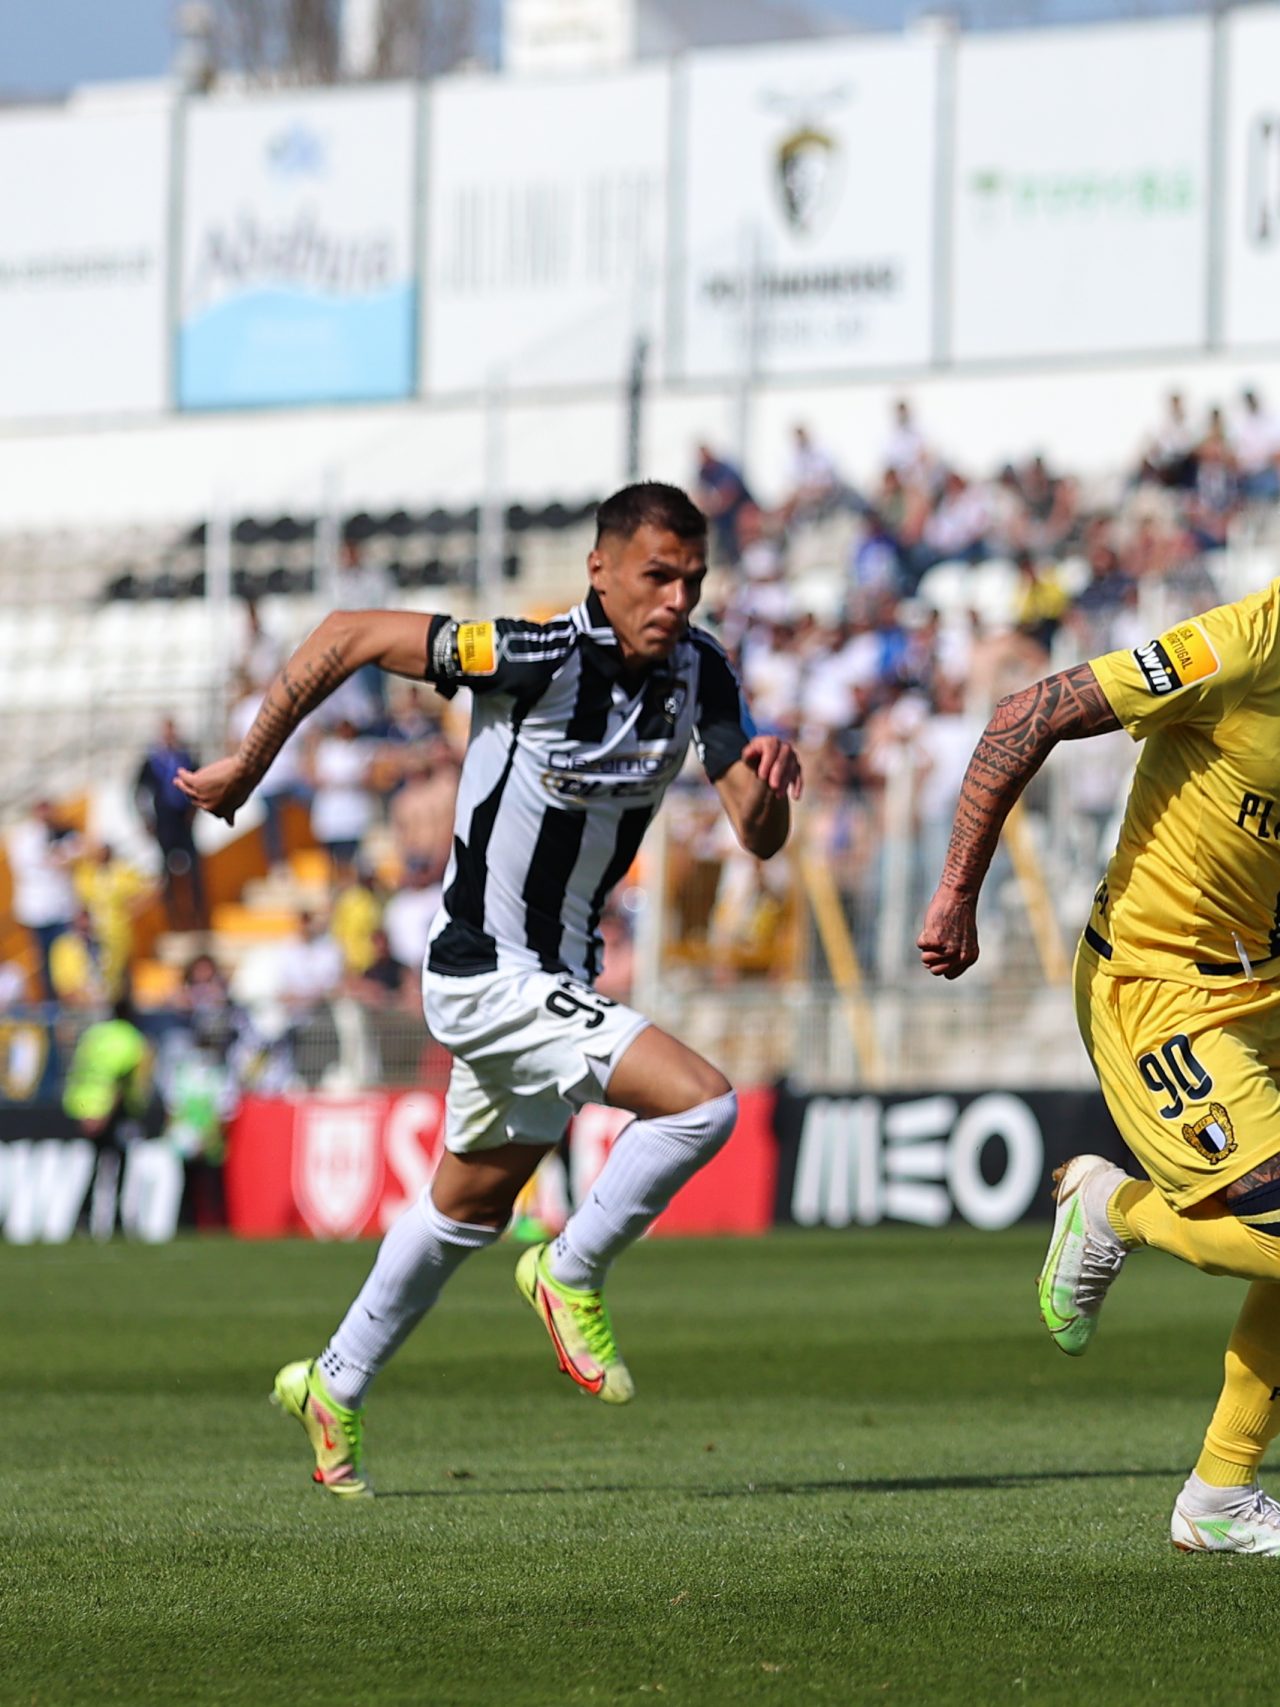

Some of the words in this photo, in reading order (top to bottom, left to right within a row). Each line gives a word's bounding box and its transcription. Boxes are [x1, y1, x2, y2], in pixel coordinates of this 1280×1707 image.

[1137, 1033, 1213, 1120] 90
[0, 1138, 184, 1244] win
[791, 1093, 1044, 1230] MEO
